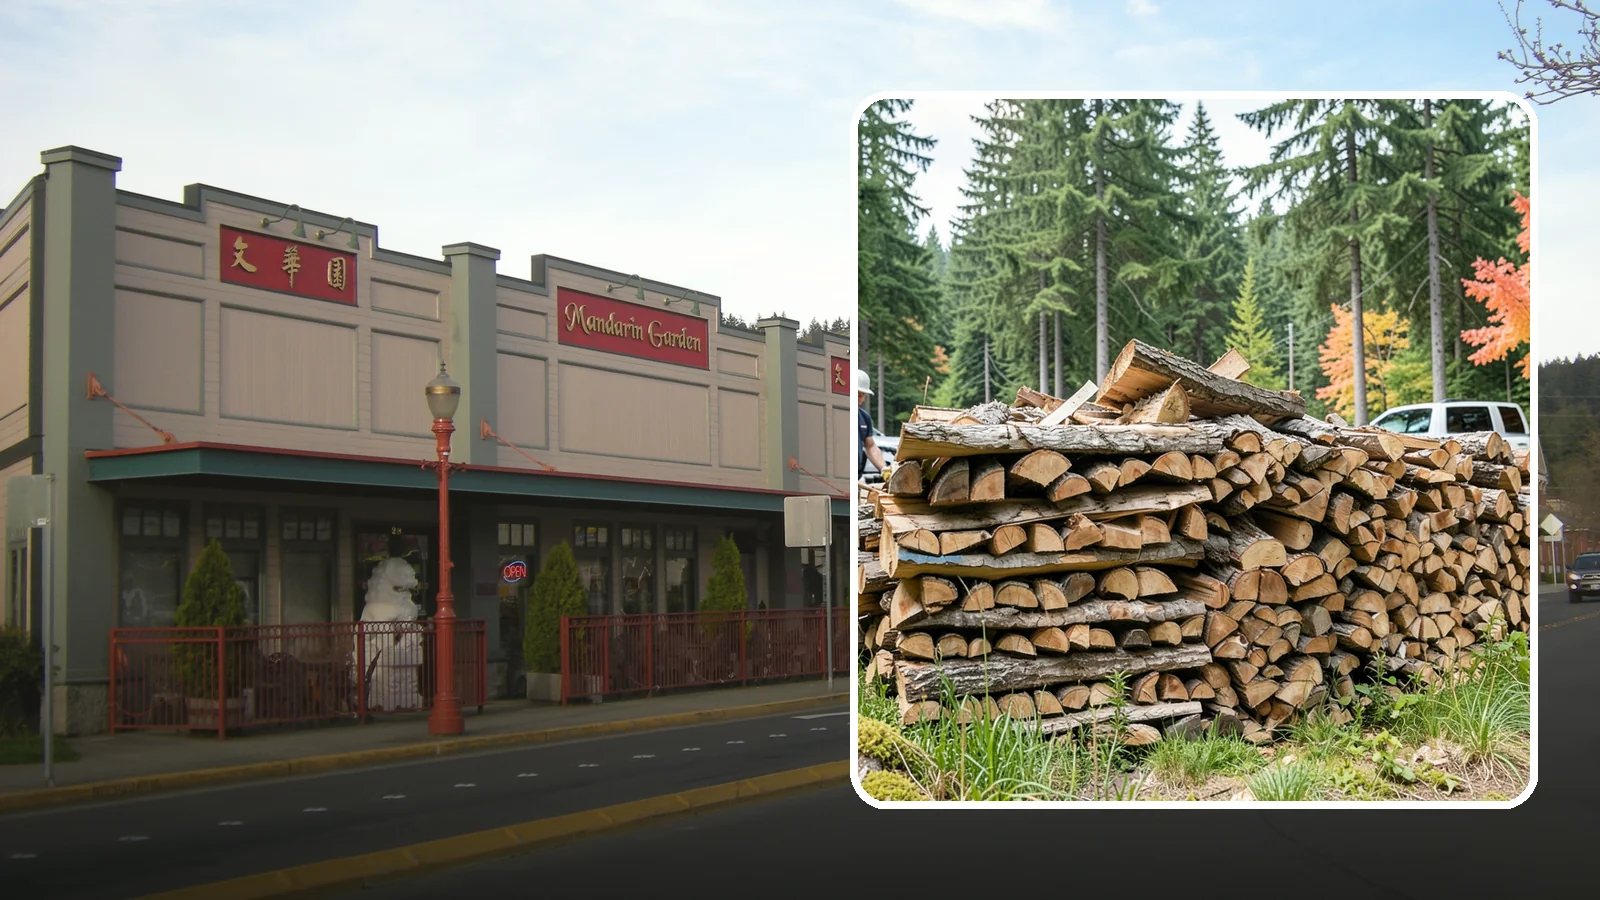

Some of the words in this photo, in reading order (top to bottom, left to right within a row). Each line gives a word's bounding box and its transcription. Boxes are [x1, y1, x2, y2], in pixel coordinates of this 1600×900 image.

[564, 302, 644, 341] Mandarin
[648, 320, 701, 352] Garden
[503, 565, 527, 578] OPEN
